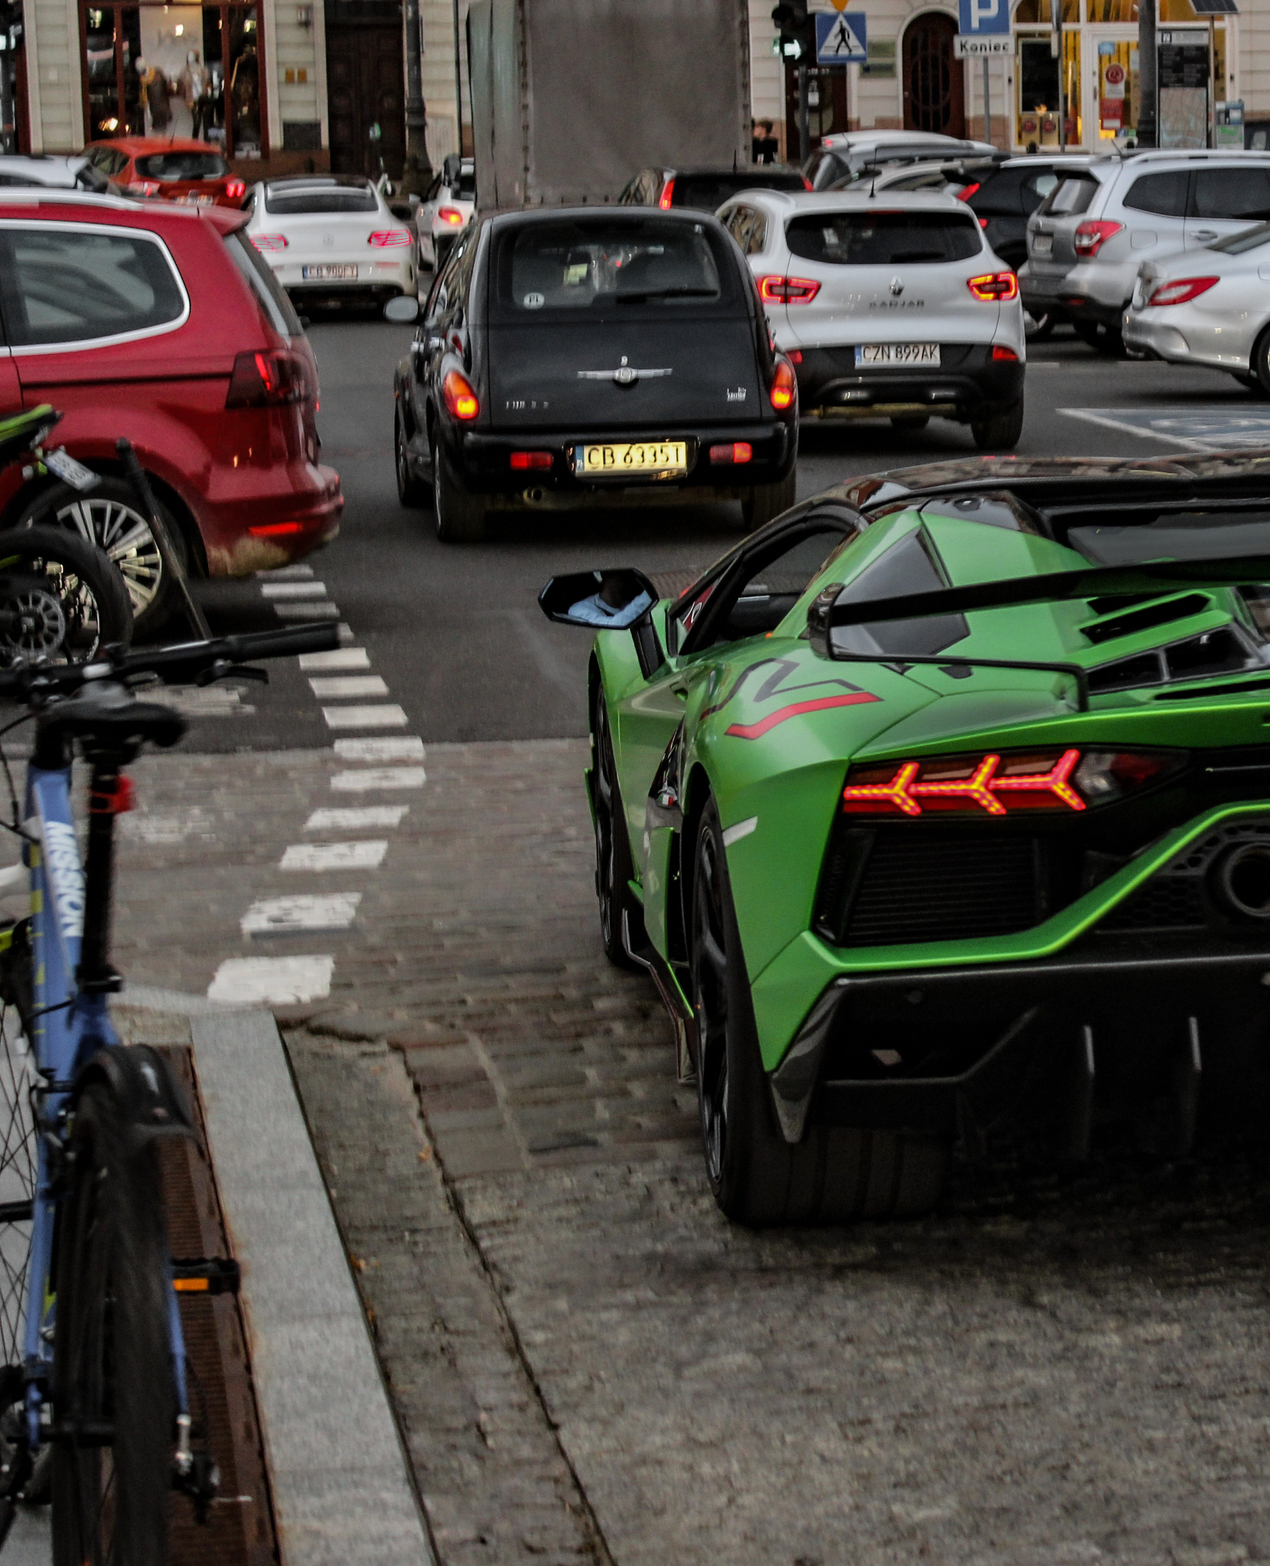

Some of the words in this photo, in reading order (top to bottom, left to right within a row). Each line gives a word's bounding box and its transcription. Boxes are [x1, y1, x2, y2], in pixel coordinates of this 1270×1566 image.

[971, 0, 999, 29] P
[960, 40, 1009, 52] Koniec
[863, 345, 891, 361] CZN
[895, 344, 937, 361] 899AK
[588, 446, 615, 466] CB
[623, 444, 683, 465] 6335T
[44, 820, 88, 938] MISSION
